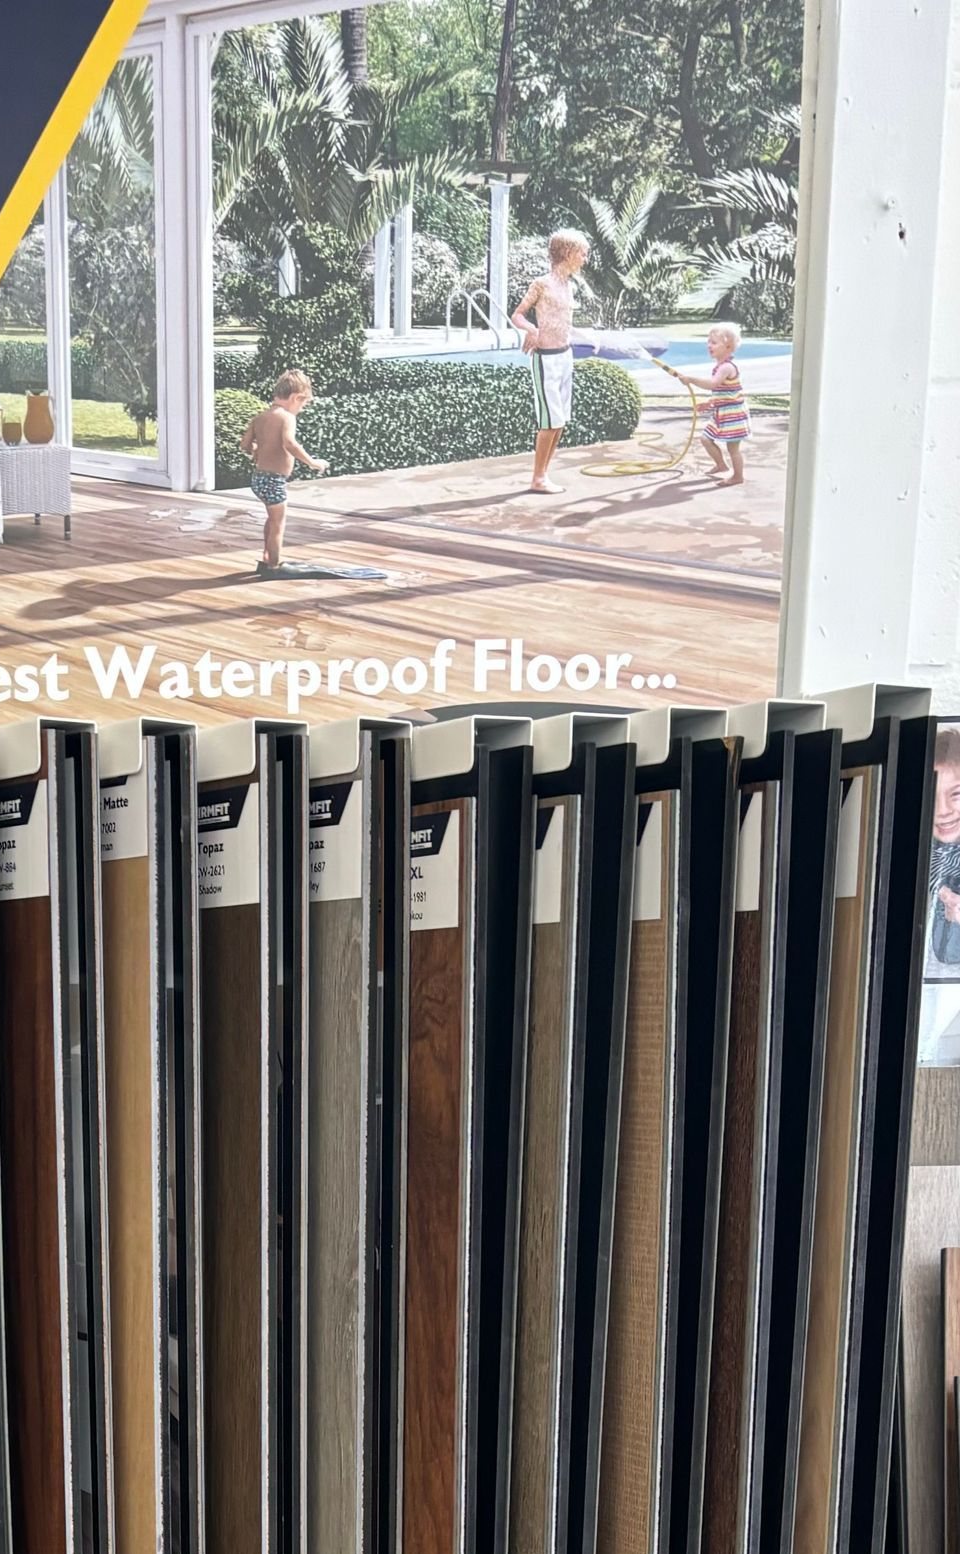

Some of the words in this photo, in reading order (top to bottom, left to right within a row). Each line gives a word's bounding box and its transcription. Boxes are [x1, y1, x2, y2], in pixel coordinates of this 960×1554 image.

[84, 639, 456, 713] Waterproof
[474, 638, 677, 692] Floor...
[103, 796, 129, 810] Matte
[198, 802, 230, 819] IRMFIT
[309, 799, 332, 814] MFIT
[198, 842, 224, 858] Topaz
[309, 840, 325, 854] paz
[199, 885, 222, 895] Shadow
